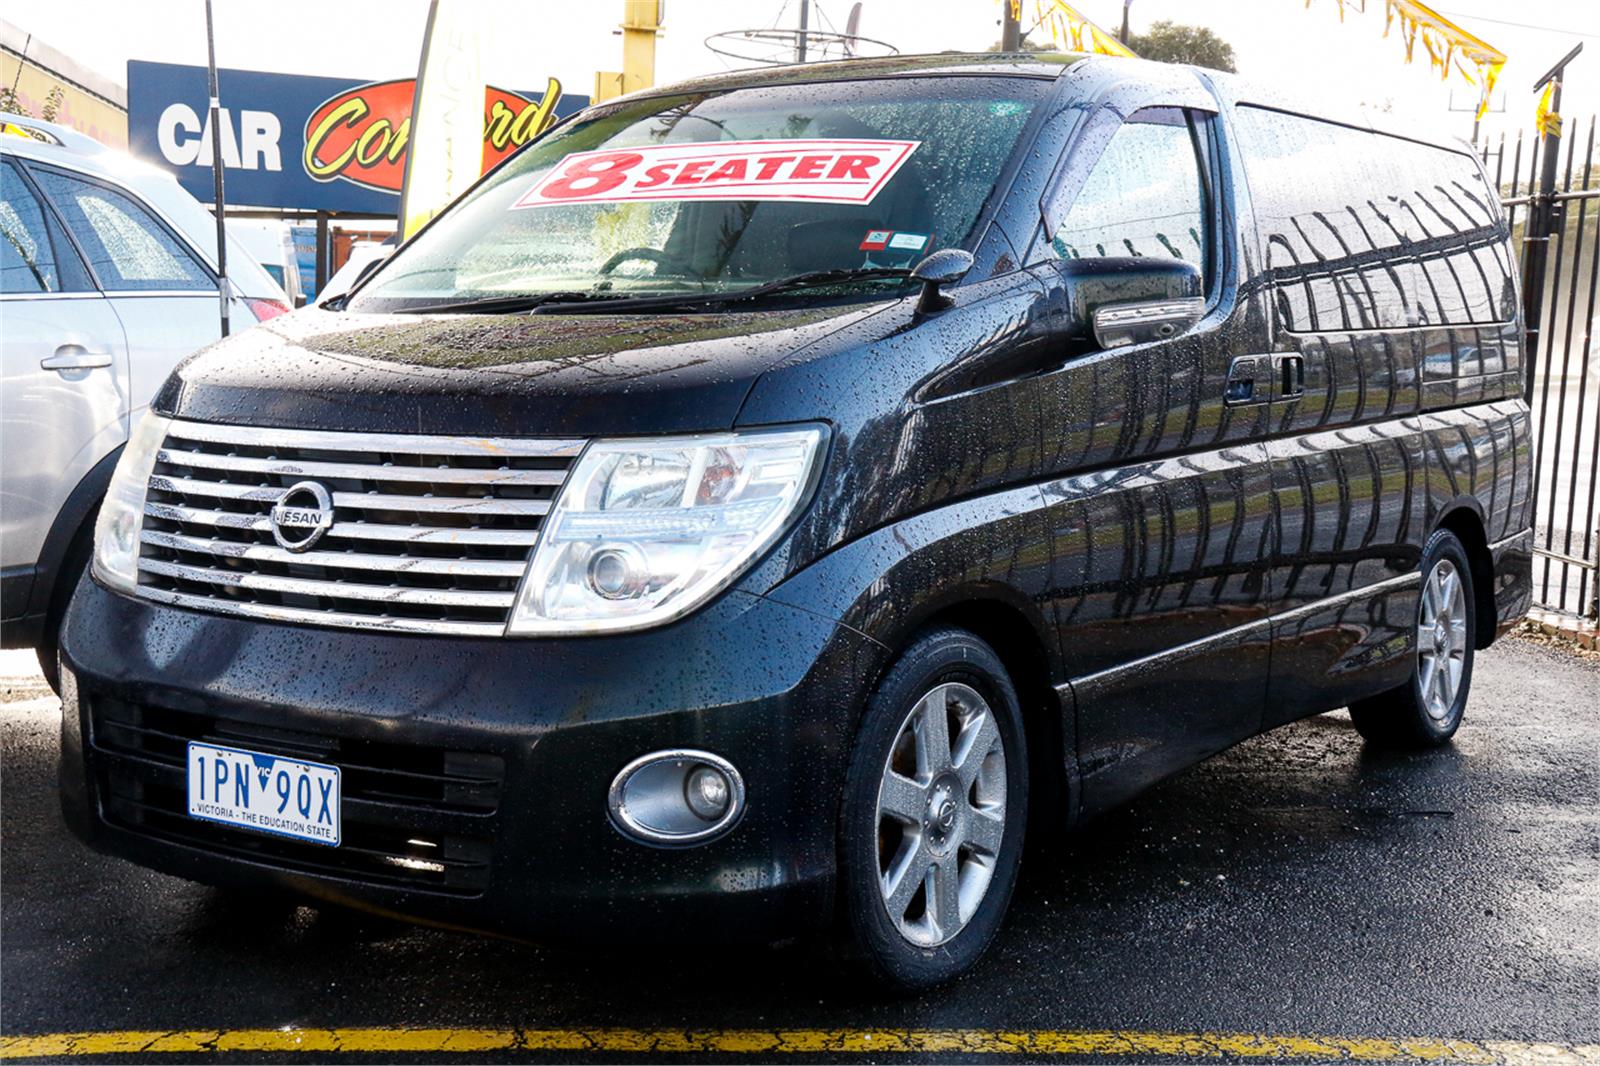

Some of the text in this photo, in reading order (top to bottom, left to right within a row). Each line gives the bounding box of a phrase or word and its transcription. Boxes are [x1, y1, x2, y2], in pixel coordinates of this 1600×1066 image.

[157, 103, 282, 171] CAR
[539, 152, 881, 198] 8 SEATER
[198, 756, 332, 826] 1PN 9QX
[197, 803, 234, 818] VICTORIA
[242, 811, 257, 824] THE
[259, 815, 305, 833] EDUCATION
[306, 824, 331, 839] STATE
